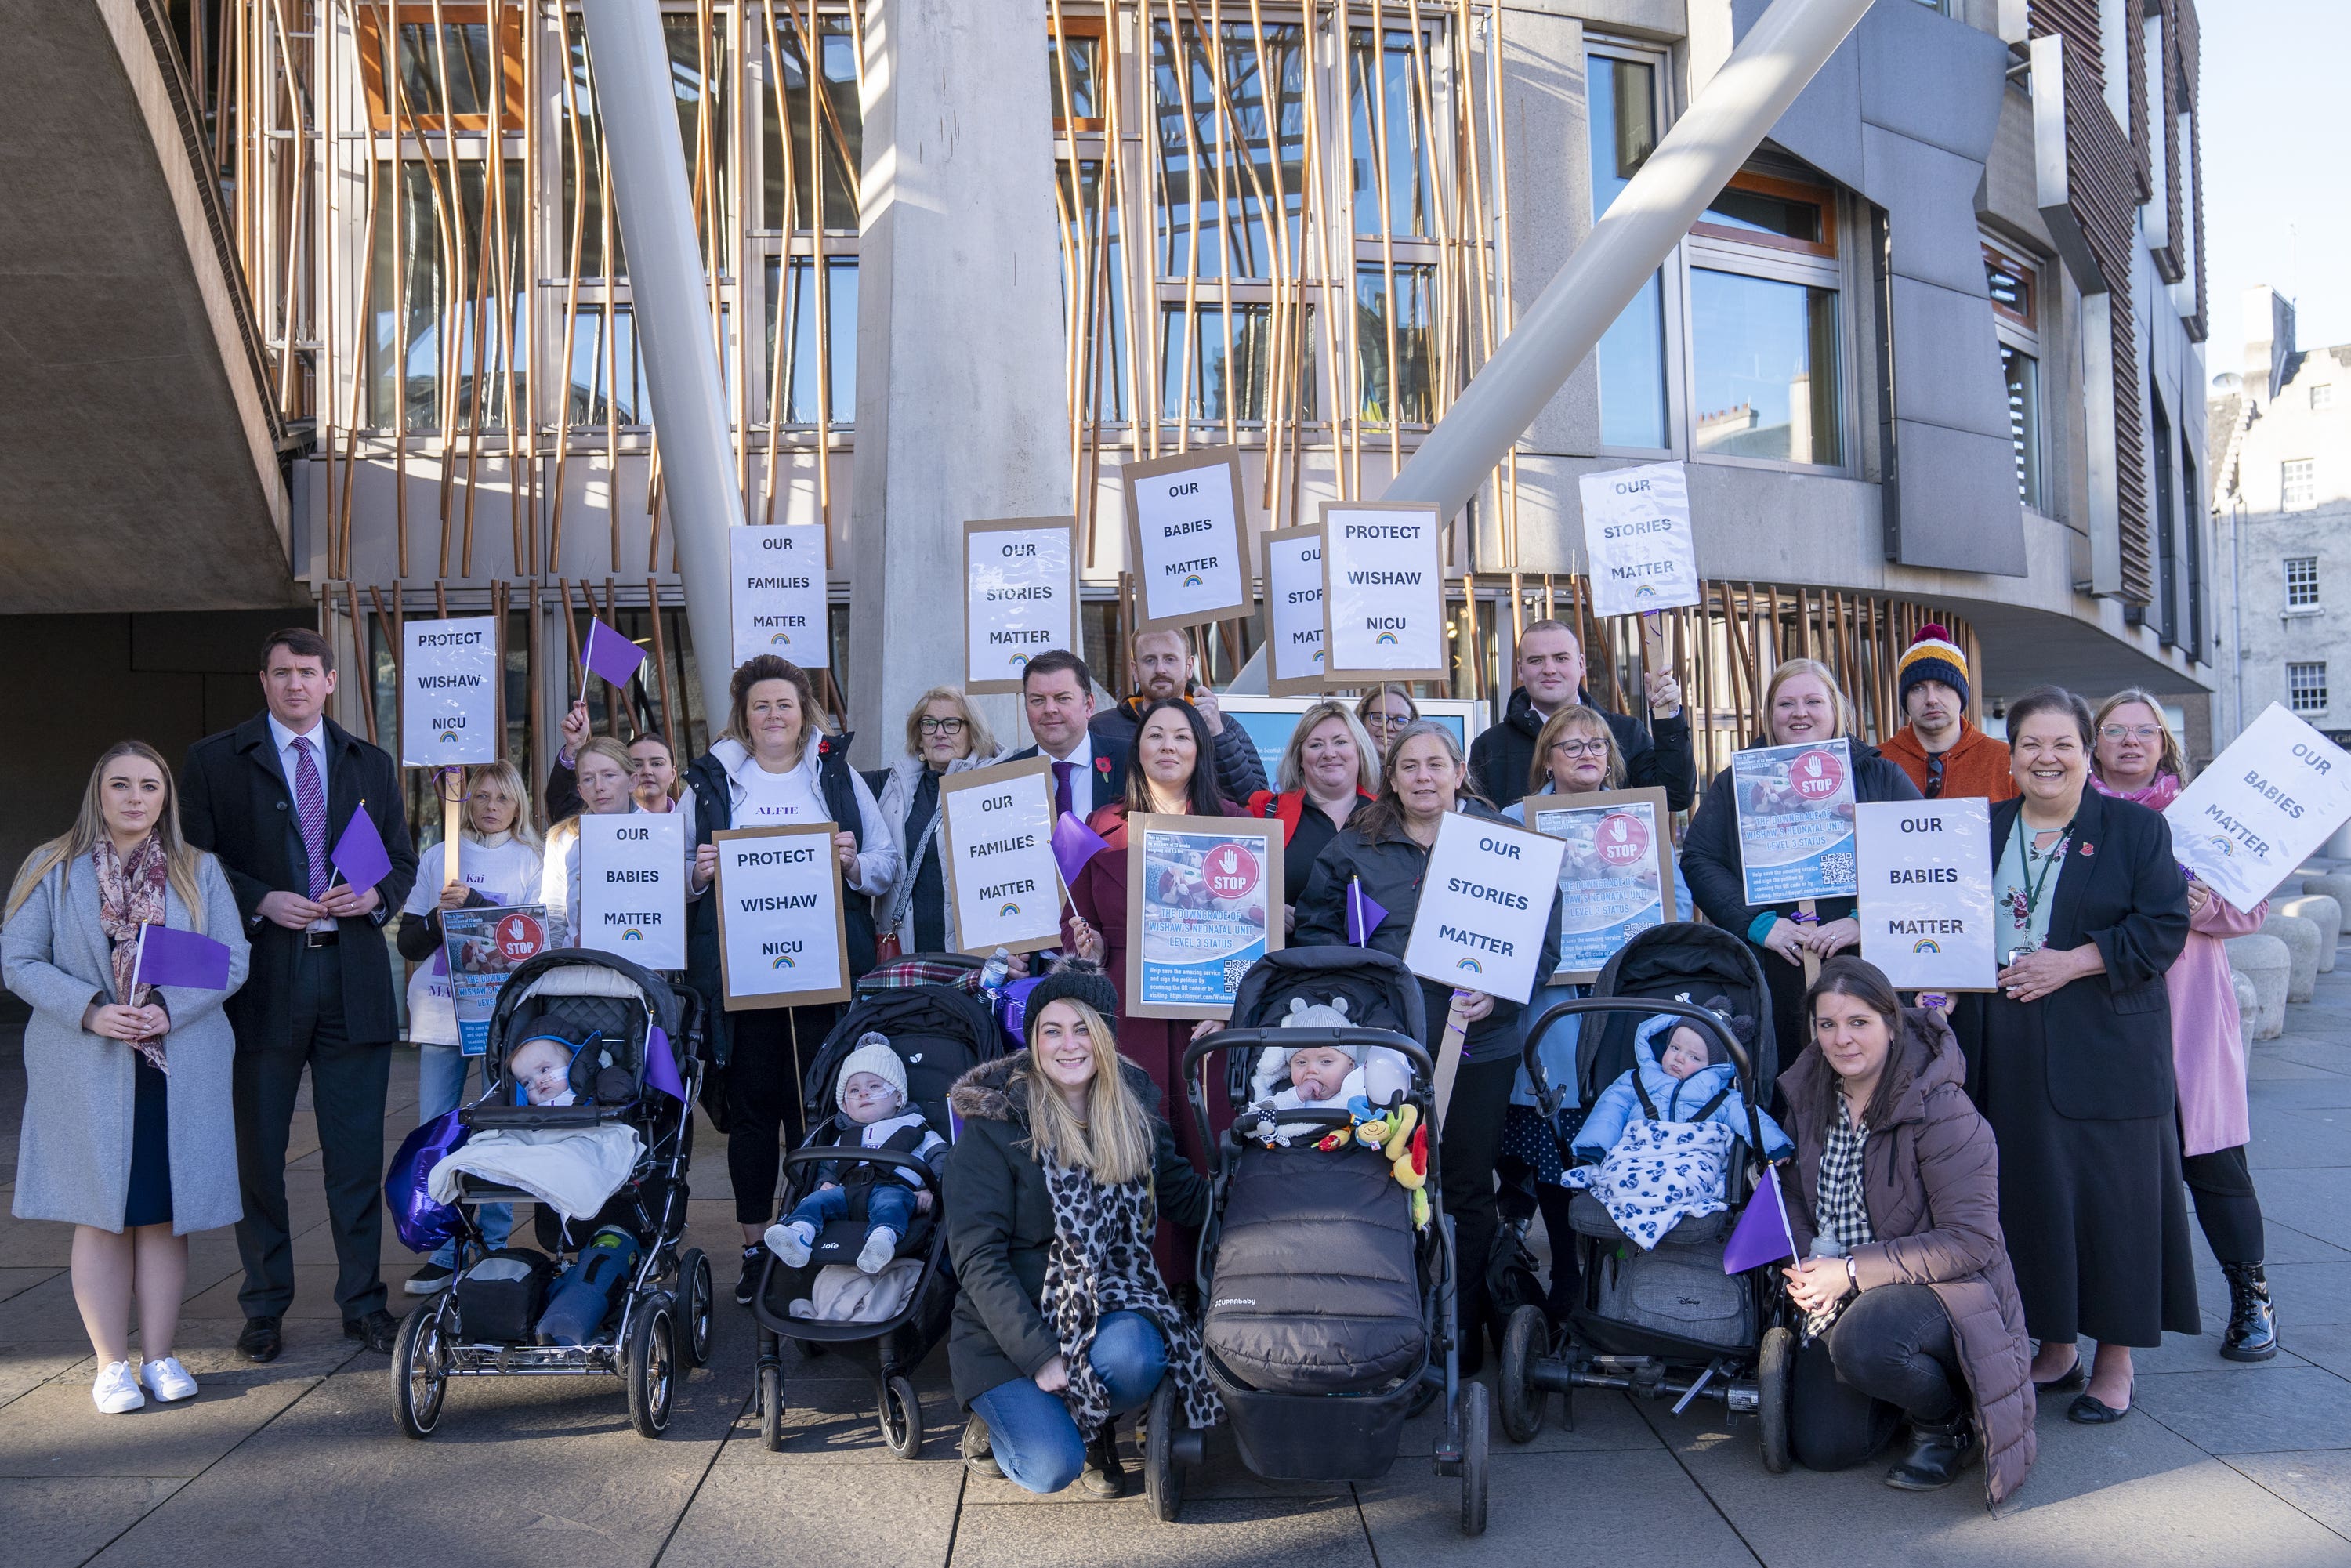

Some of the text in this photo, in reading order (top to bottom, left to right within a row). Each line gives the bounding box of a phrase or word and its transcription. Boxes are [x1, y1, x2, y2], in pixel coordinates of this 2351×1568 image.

[1169, 483, 1198, 497] OUR
[1616, 480, 1650, 494] OUR
[1164, 519, 1212, 538] BABIES
[1346, 526, 1420, 538] PROTECT
[1604, 519, 1672, 538] STORIES
[763, 538, 792, 549] OUR
[1002, 544, 1036, 557] OUR
[1165, 557, 1218, 577] MATTER
[1611, 561, 1674, 579] MATTER
[748, 578, 809, 588] FAMILIES
[1348, 572, 1421, 585] WISHAW
[987, 587, 1052, 601] STORIES
[754, 616, 806, 627] MATTER
[1367, 617, 1405, 630] NICU
[419, 632, 482, 646] PROTECT
[990, 631, 1050, 644] MATTER
[1293, 629, 1324, 644] MAT
[418, 675, 480, 689] WISHAW
[433, 717, 465, 730] NICU
[2291, 743, 2332, 776] OUR
[1802, 777, 1833, 793] STOP
[2243, 770, 2305, 819] BABIES
[982, 795, 1013, 812] OUR
[1755, 810, 1831, 826] THE DOWNGRADE OF
[1787, 823, 1825, 835] NEONATAL
[1827, 821, 1844, 831] UNIT
[1901, 818, 1942, 833] OUR
[2204, 804, 2269, 858] MATTER
[617, 828, 649, 840] OUR
[970, 835, 1034, 858] FAMILIES
[1480, 838, 1520, 860] OUR
[1767, 836, 1826, 850] LEVEL 3 STATUS
[738, 849, 814, 867] PROTECT
[1607, 843, 1638, 859] STOP
[466, 874, 485, 883] Kai
[607, 871, 659, 882] BABIES
[1214, 876, 1247, 890] STOP
[1890, 868, 1958, 884] BABIES
[980, 879, 1034, 900] MATTER
[1560, 878, 1636, 892] THE DOWNGRADE OF
[1448, 878, 1528, 910] STORIES
[1591, 890, 1628, 903] NEONATAL
[1630, 889, 1648, 900] UNIT
[741, 894, 817, 911] WISHAW
[1161, 909, 1241, 921] THE DOWNGRADE OF
[1570, 904, 1629, 917] LEVEL 3 STATUS
[605, 913, 661, 925] MATTER
[1193, 925, 1232, 935] NEONATAL
[1235, 926, 1254, 935] UNIT
[1889, 920, 1963, 934] MATTER
[763, 940, 802, 955] NICU
[1169, 937, 1194, 947] LEVEL
[1204, 939, 1232, 948] STATUS
[1439, 925, 1513, 957] MATTER
[506, 942, 534, 955] STOP
[466, 975, 480, 984] THE
